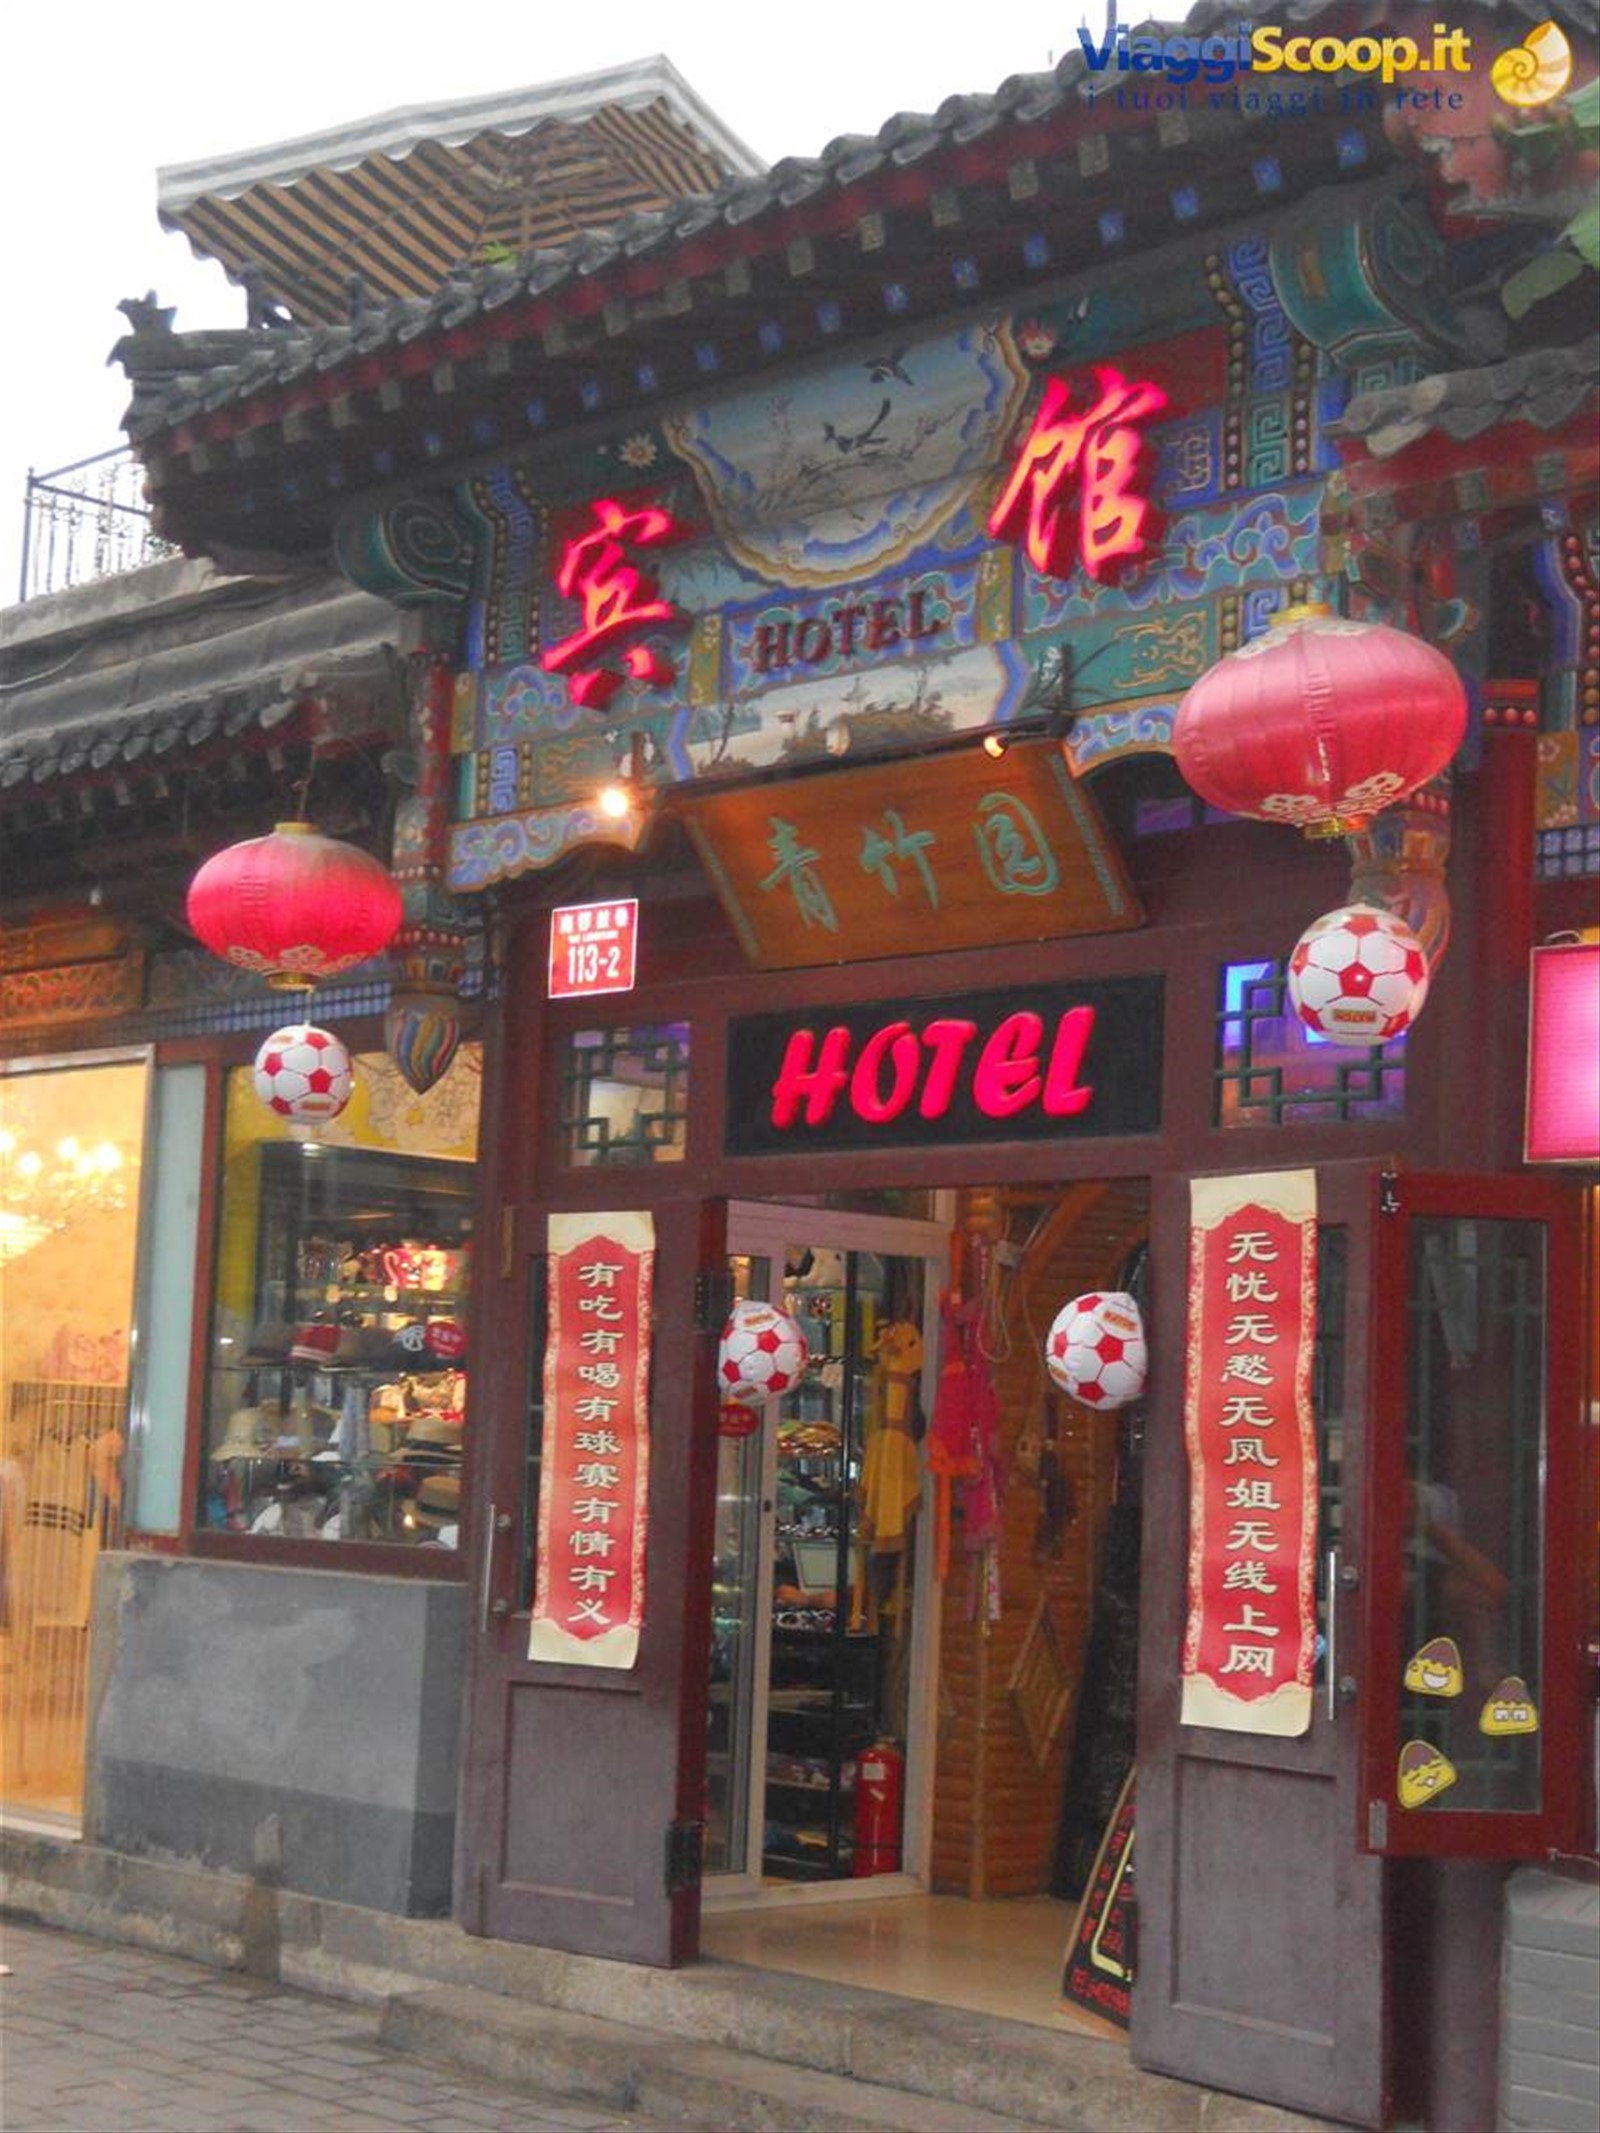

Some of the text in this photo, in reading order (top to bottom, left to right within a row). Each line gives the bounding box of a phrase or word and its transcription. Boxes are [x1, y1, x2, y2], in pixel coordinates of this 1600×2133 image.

[541, 366, 1168, 706] 宾 馆
[752, 590, 945, 674] HOTEL
[567, 943, 621, 985] 113-2
[566, 1261, 624, 1626] 有吃有喝有球赛有情有义
[1218, 1230, 1281, 1678] 无忧无愁无凤姐无线上网
